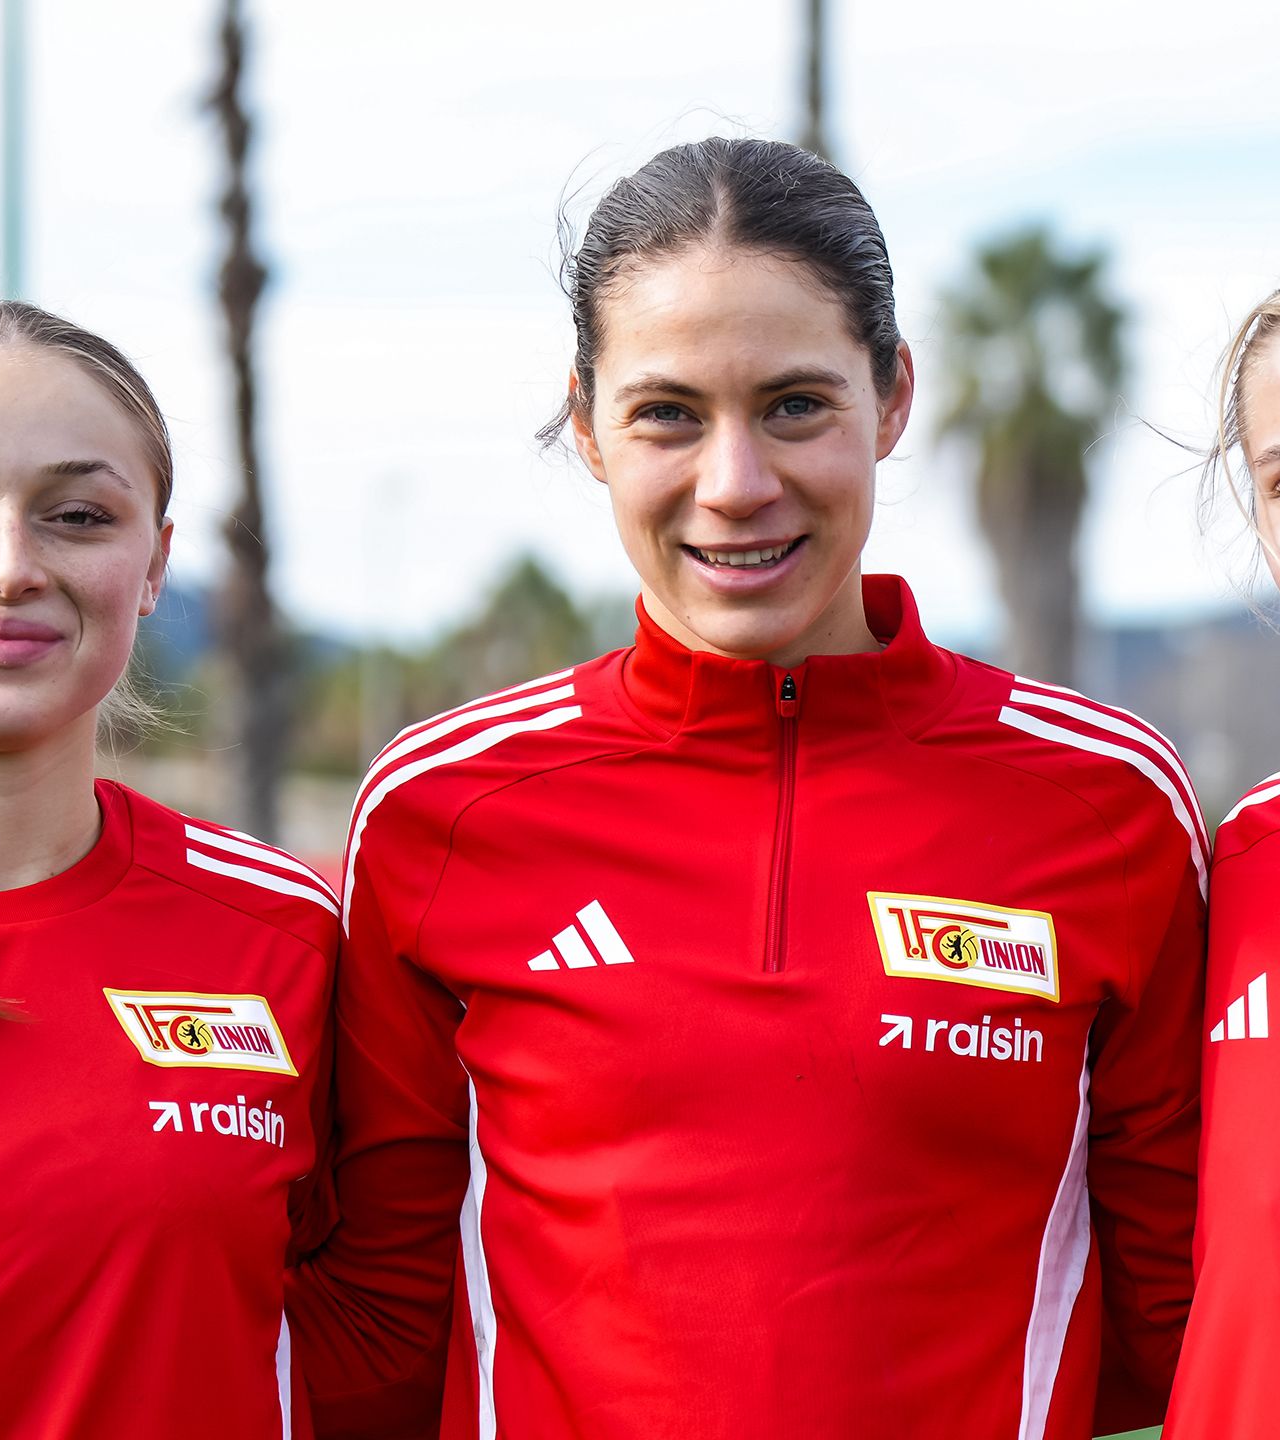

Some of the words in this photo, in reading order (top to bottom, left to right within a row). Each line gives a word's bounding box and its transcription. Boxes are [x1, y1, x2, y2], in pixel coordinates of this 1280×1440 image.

[980, 937, 1046, 976] UNION
[210, 1025, 276, 1055] UNION
[925, 1014, 1044, 1063] raisin
[189, 1095, 285, 1148] raisin
